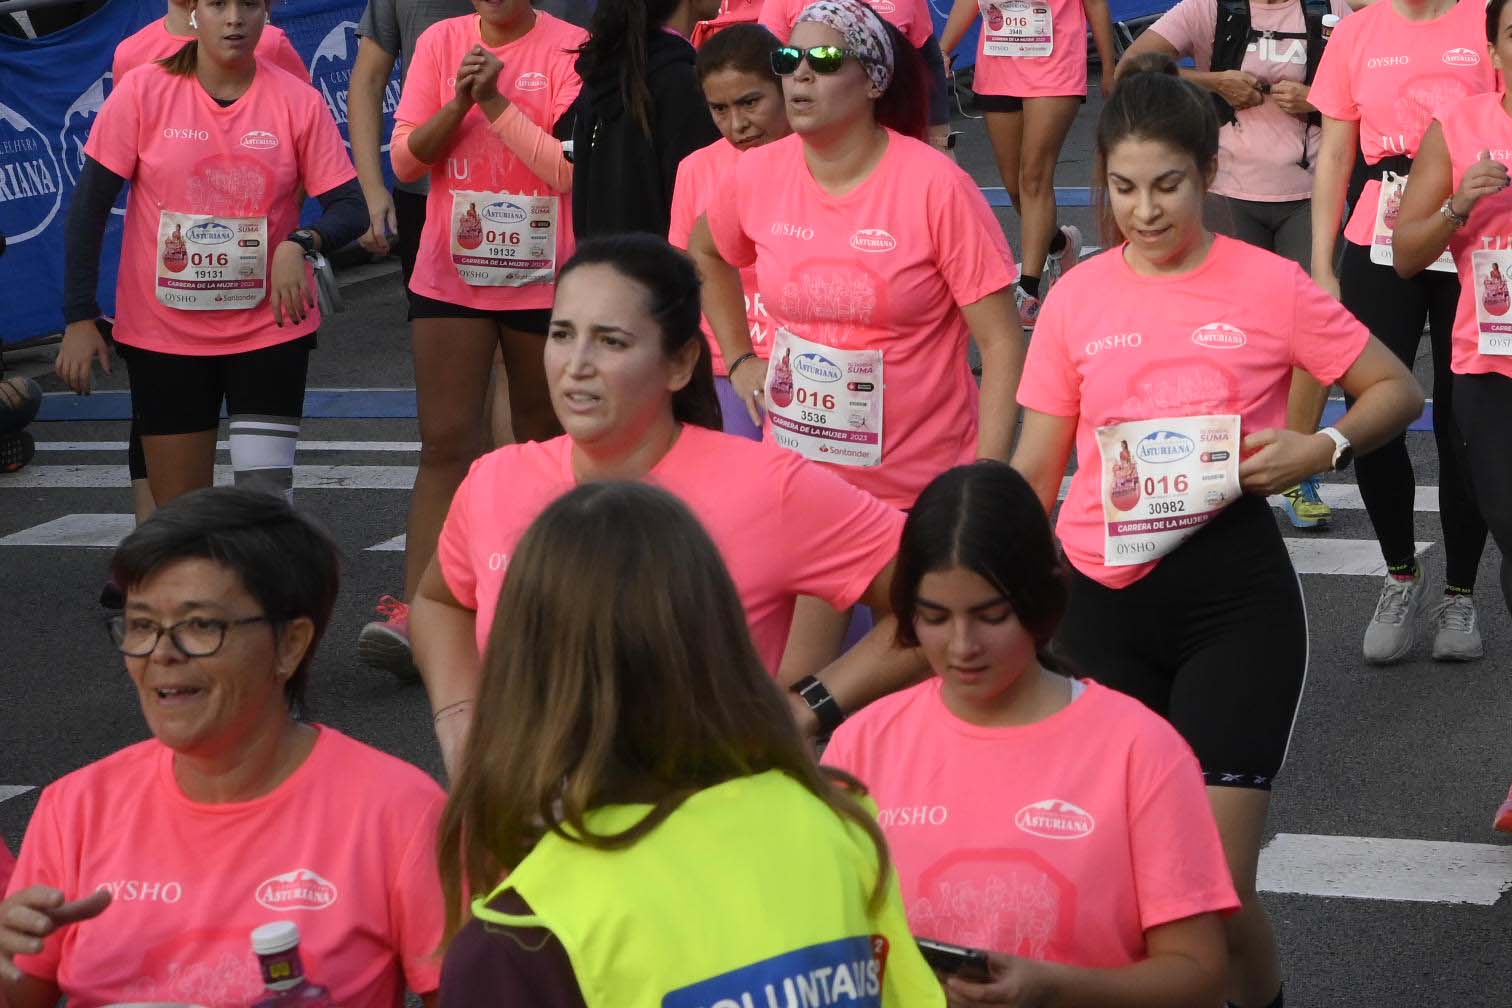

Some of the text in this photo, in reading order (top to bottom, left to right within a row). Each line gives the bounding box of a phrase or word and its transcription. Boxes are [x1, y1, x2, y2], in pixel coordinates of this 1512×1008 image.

[1005, 16, 1027, 27] 016
[1368, 55, 1409, 69] OYSHO
[163, 128, 209, 142] OYSHO
[486, 208, 524, 220] ASTURIANA
[486, 230, 521, 245] 016
[488, 247, 516, 257] 19132
[191, 253, 229, 266] 016
[461, 257, 491, 265] CARRERA
[195, 270, 223, 279] 19131
[168, 280, 196, 289] CARRERA
[165, 293, 197, 303] OYSHO
[1085, 332, 1142, 356] OYSHO
[797, 362, 838, 379] ASTURIANA
[796, 388, 836, 410] 016
[801, 410, 827, 424] 3536
[773, 416, 868, 442] CARRERA DE LA MUJER 2023
[1199, 433, 1229, 442] SUMA
[829, 446, 870, 458] Santander
[1140, 443, 1191, 457] ASTURIANA
[1144, 474, 1189, 496] 016
[1148, 500, 1186, 515] 30982
[1117, 521, 1152, 533] CARRERA
[1153, 519, 1165, 529] DE
[1166, 518, 1178, 528] LA
[1117, 542, 1156, 554] OYSHO
[1020, 812, 1089, 832] ASTURIANA
